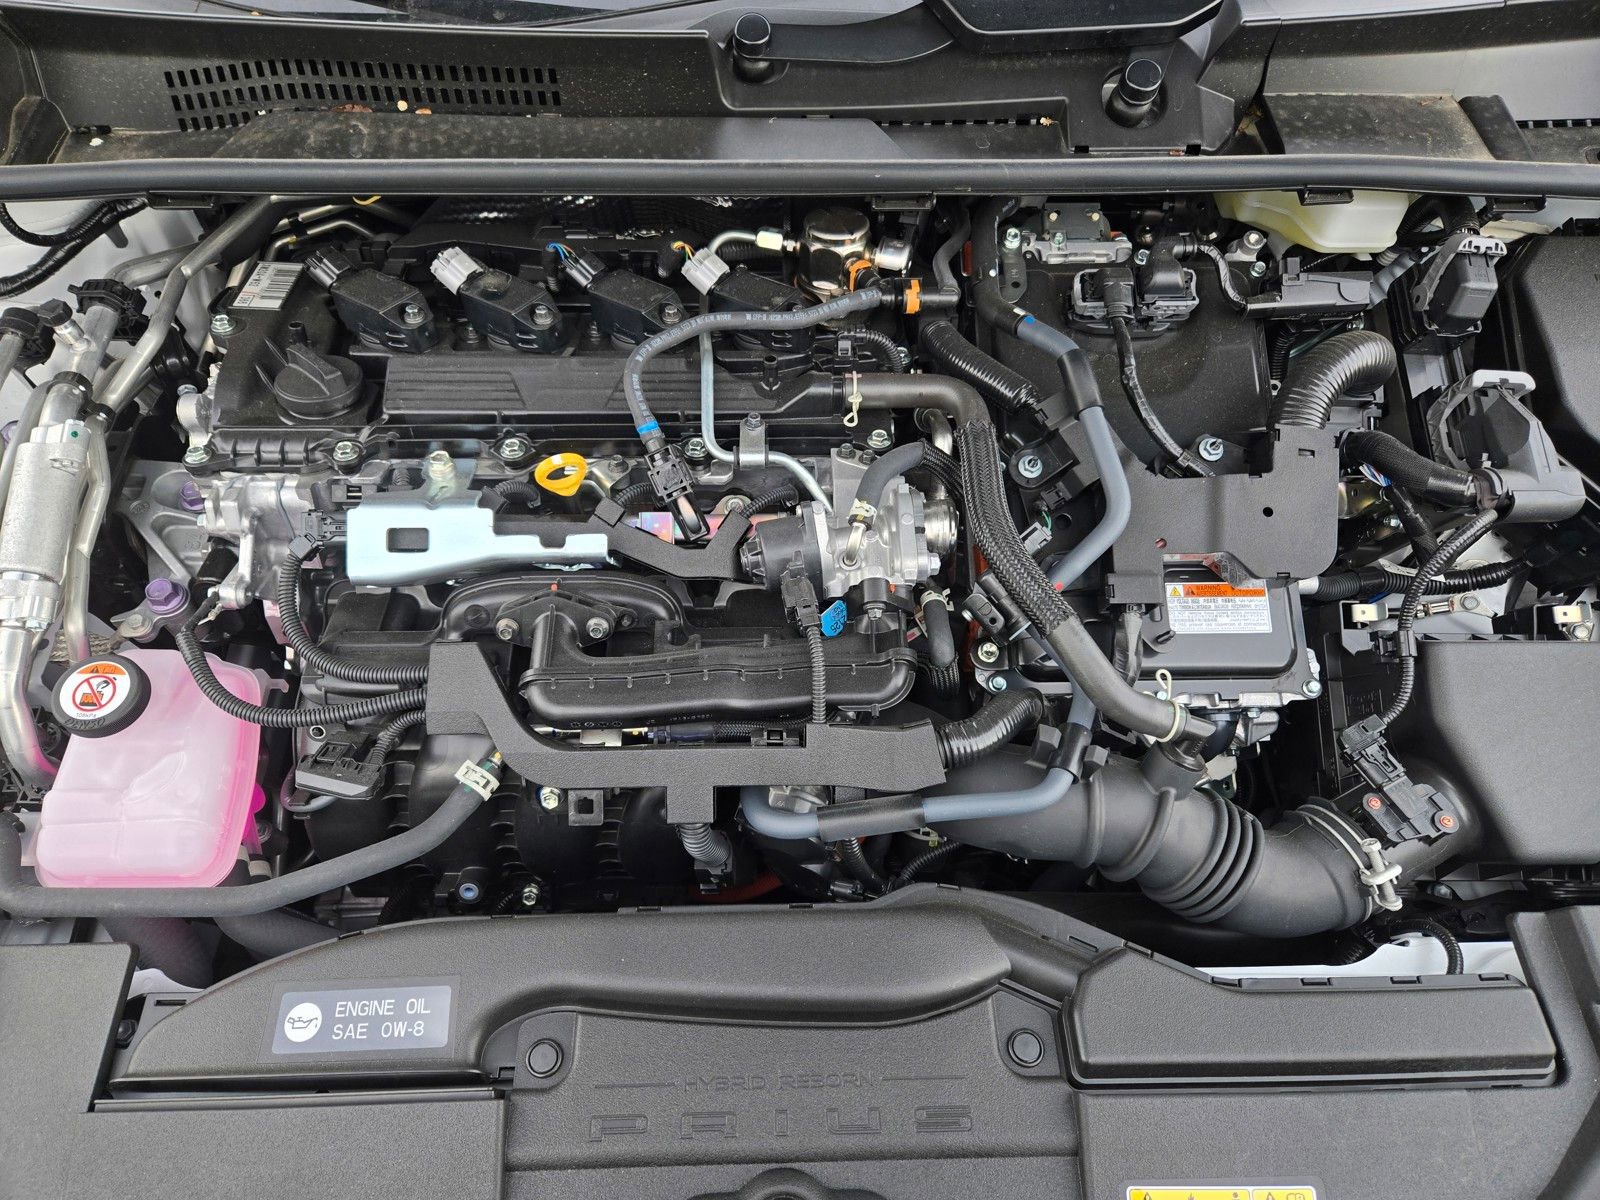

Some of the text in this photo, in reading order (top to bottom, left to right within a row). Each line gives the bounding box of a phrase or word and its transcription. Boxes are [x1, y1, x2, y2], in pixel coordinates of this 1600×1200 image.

[335, 998, 430, 1018] ENGINE OIL
[331, 1020, 424, 1040] SAE 0W-8
[684, 1073, 874, 1092] HYBRID REBORN
[589, 1104, 973, 1143] PRIUS
